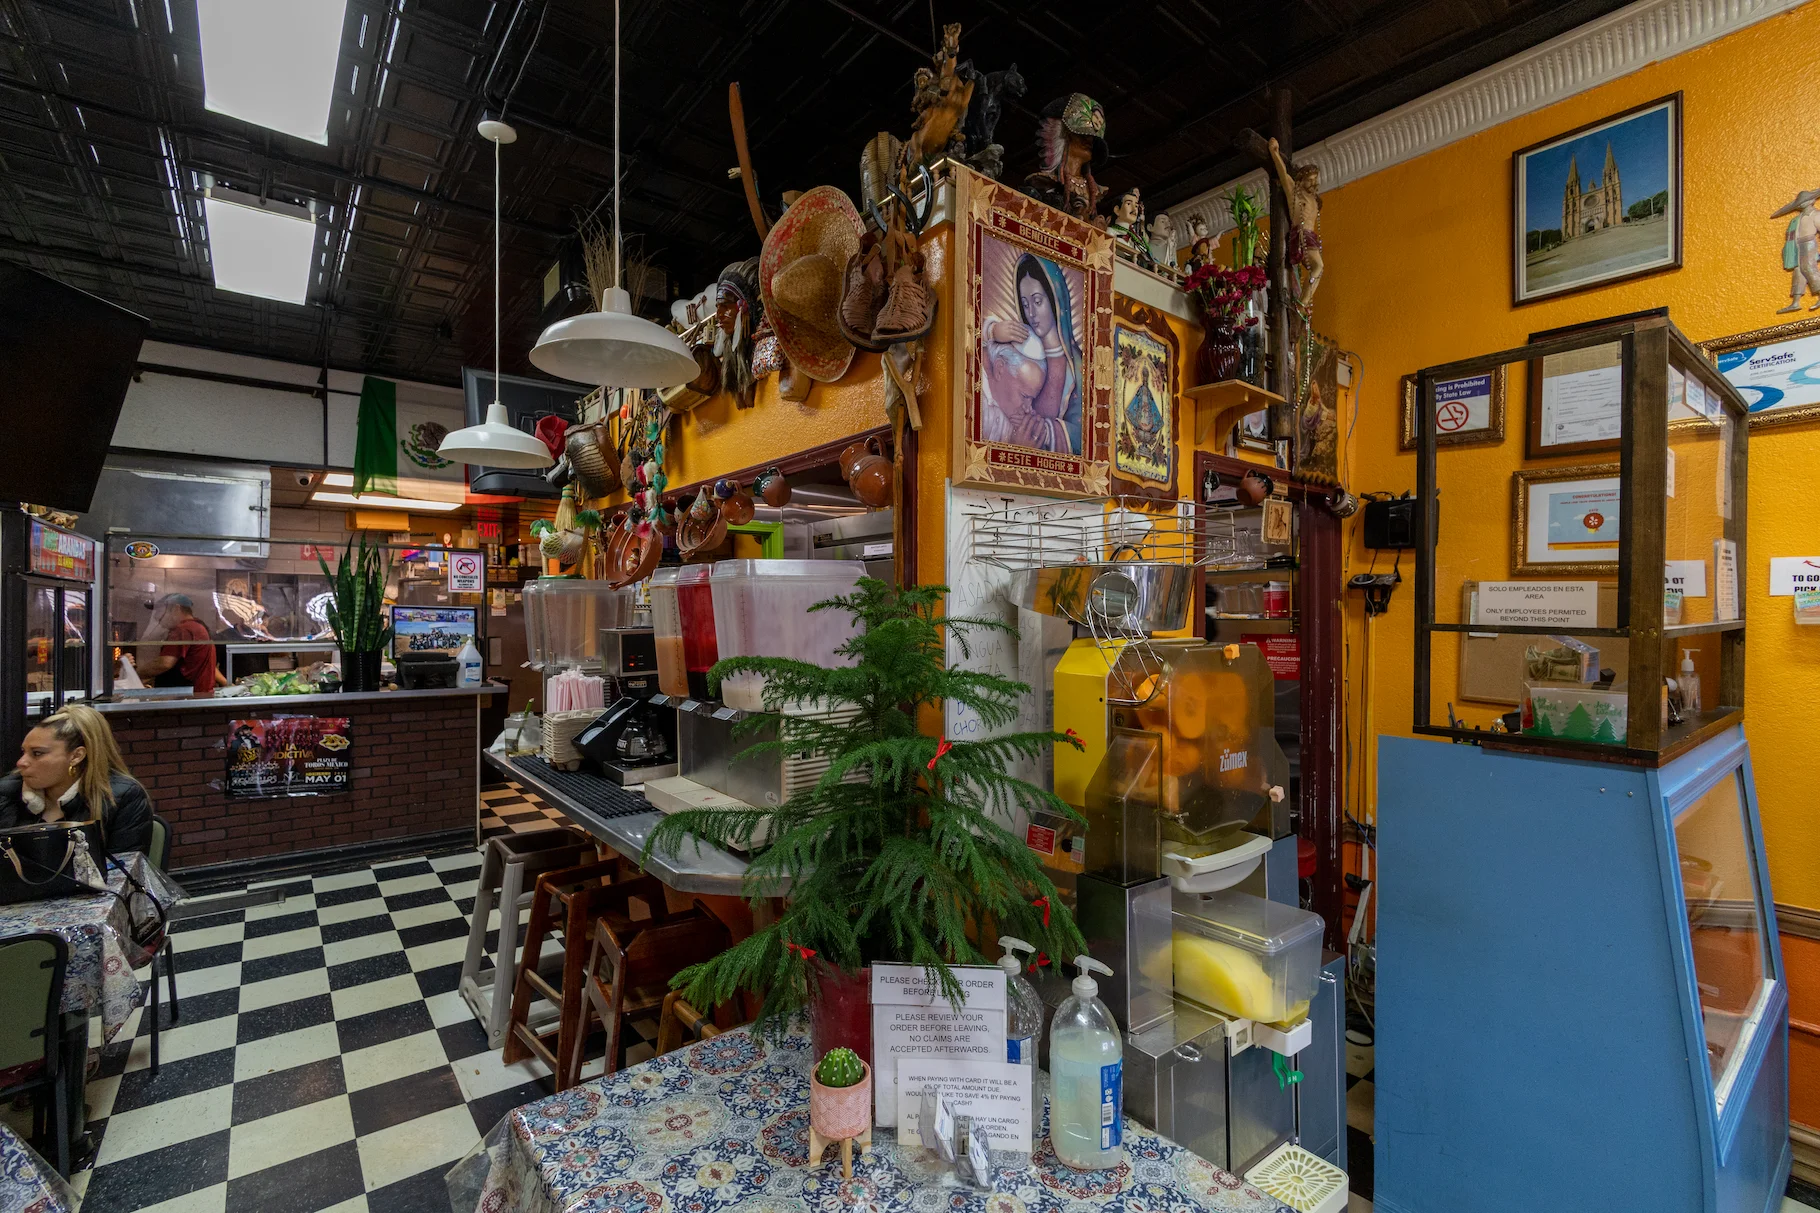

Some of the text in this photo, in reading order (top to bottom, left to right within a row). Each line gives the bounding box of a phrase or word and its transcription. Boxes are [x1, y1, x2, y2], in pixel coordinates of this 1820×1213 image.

[1019, 224, 1060, 250] BENDICE
[1749, 352, 1793, 366] ServSafe
[1749, 358, 1796, 370] CERTIFICATION
[1454, 379, 1486, 390] Prohibited
[1008, 452, 1066, 472] ESTE HOGAR
[478, 522, 498, 538] EXIT
[286, 743, 297, 751] LA
[966, 980, 994, 988] ORDER
[904, 988, 934, 996] BEFORE
